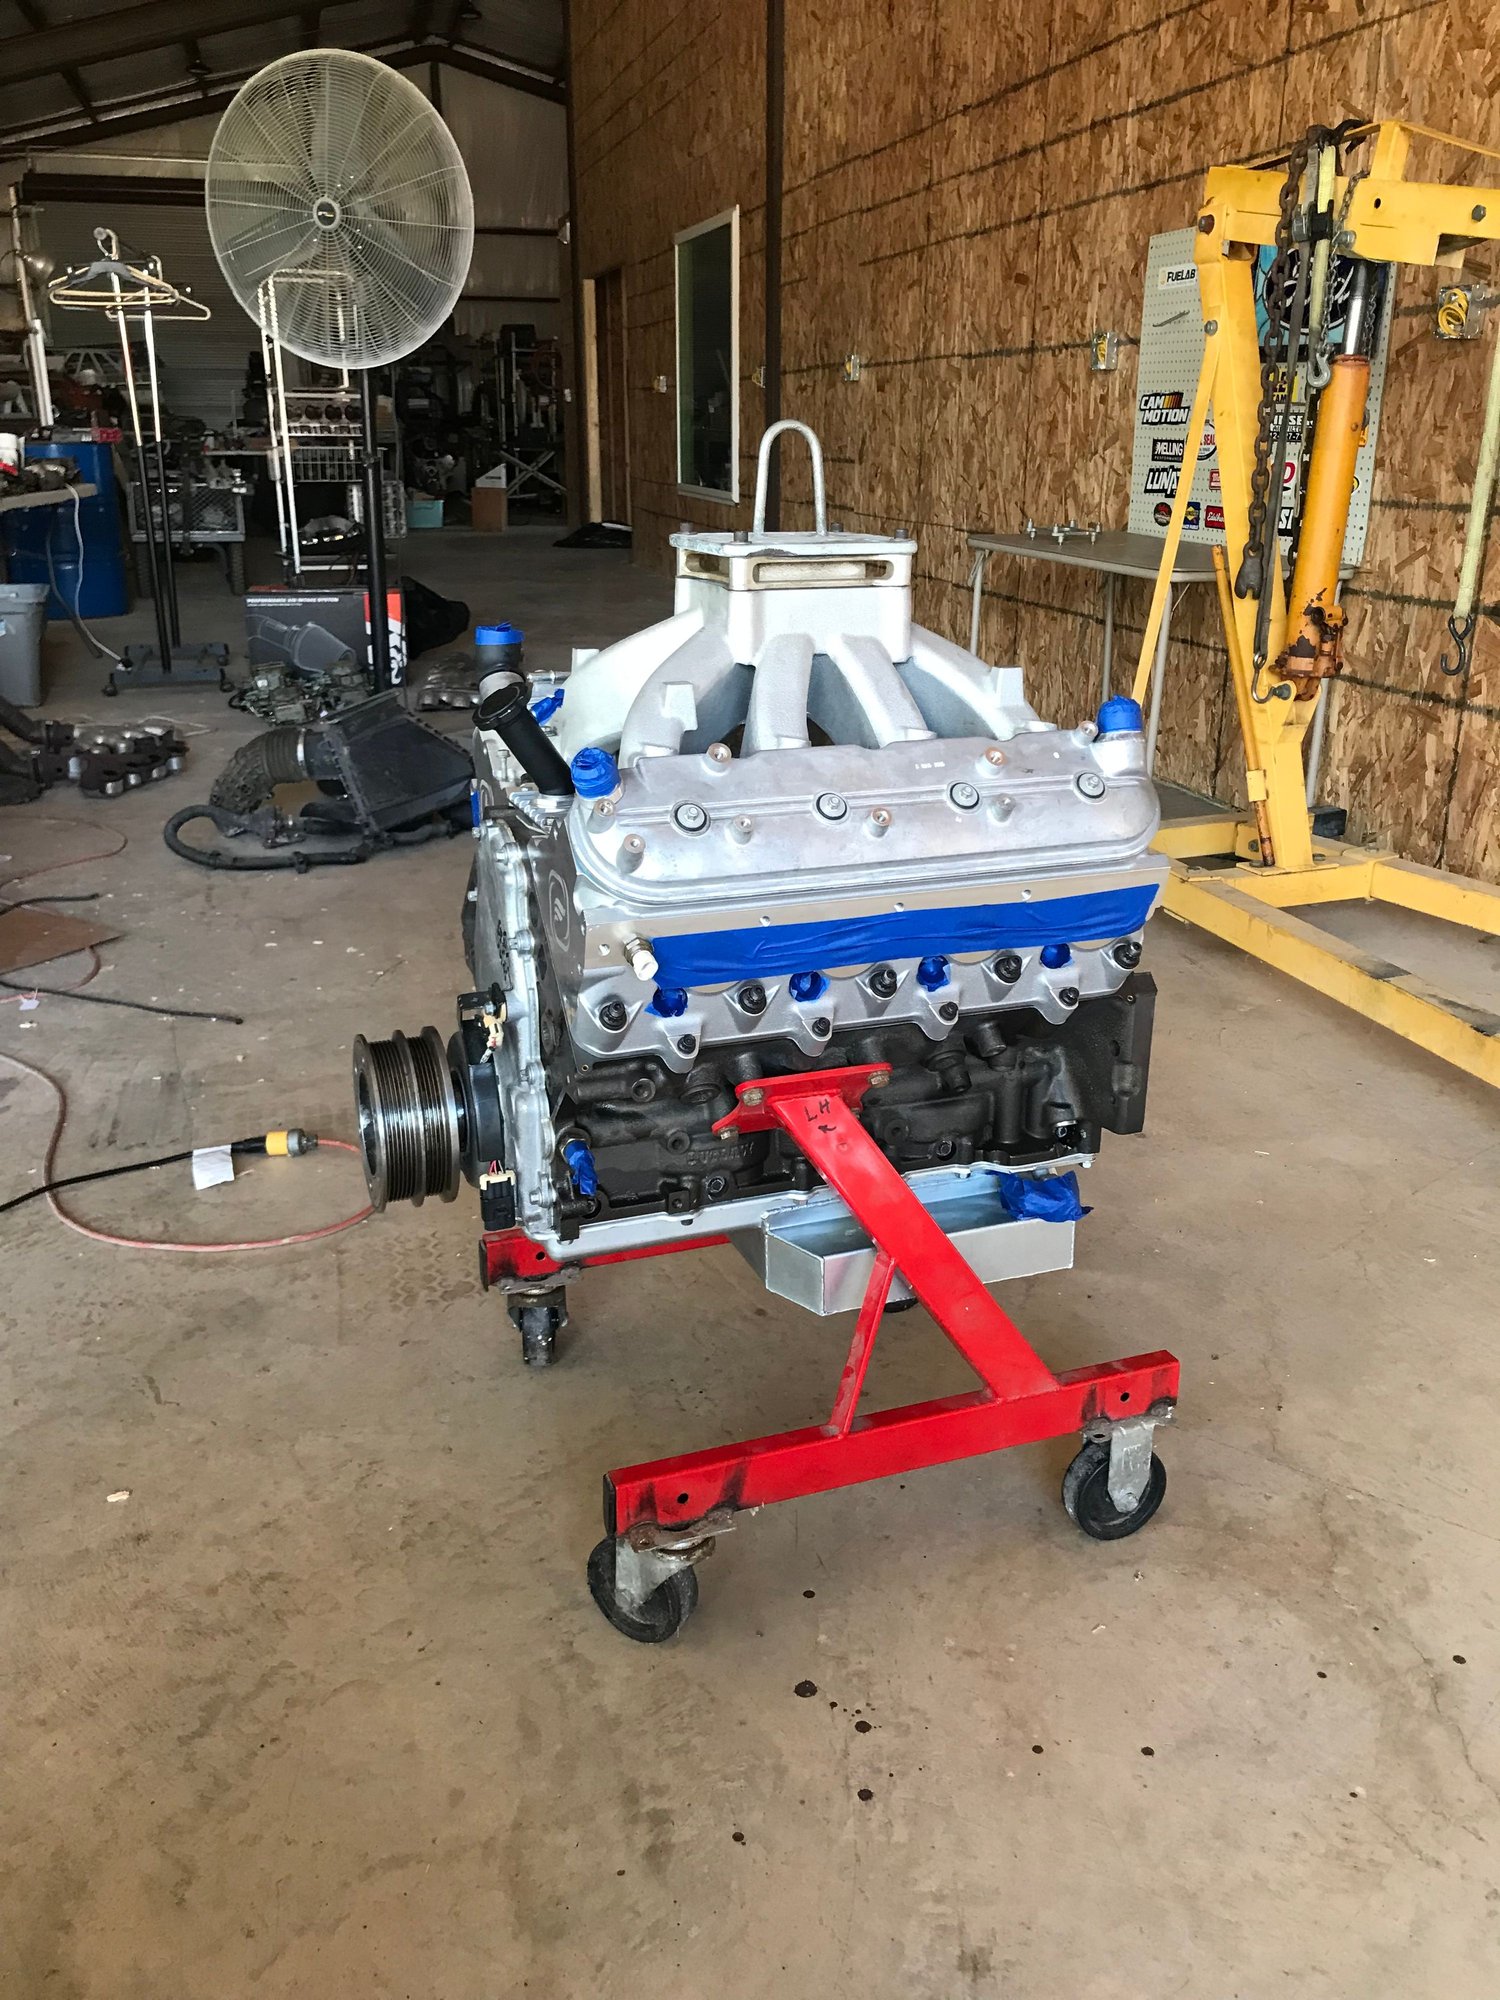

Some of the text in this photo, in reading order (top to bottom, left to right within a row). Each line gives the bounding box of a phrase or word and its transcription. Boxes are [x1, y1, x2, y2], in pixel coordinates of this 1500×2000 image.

[1166, 268, 1196, 283] FUELAB
[1140, 395, 1165, 410] CAM
[1143, 408, 1189, 423] MOTION
[1154, 441, 1184, 456] MELLING
[804, 1099, 831, 1122] LH
